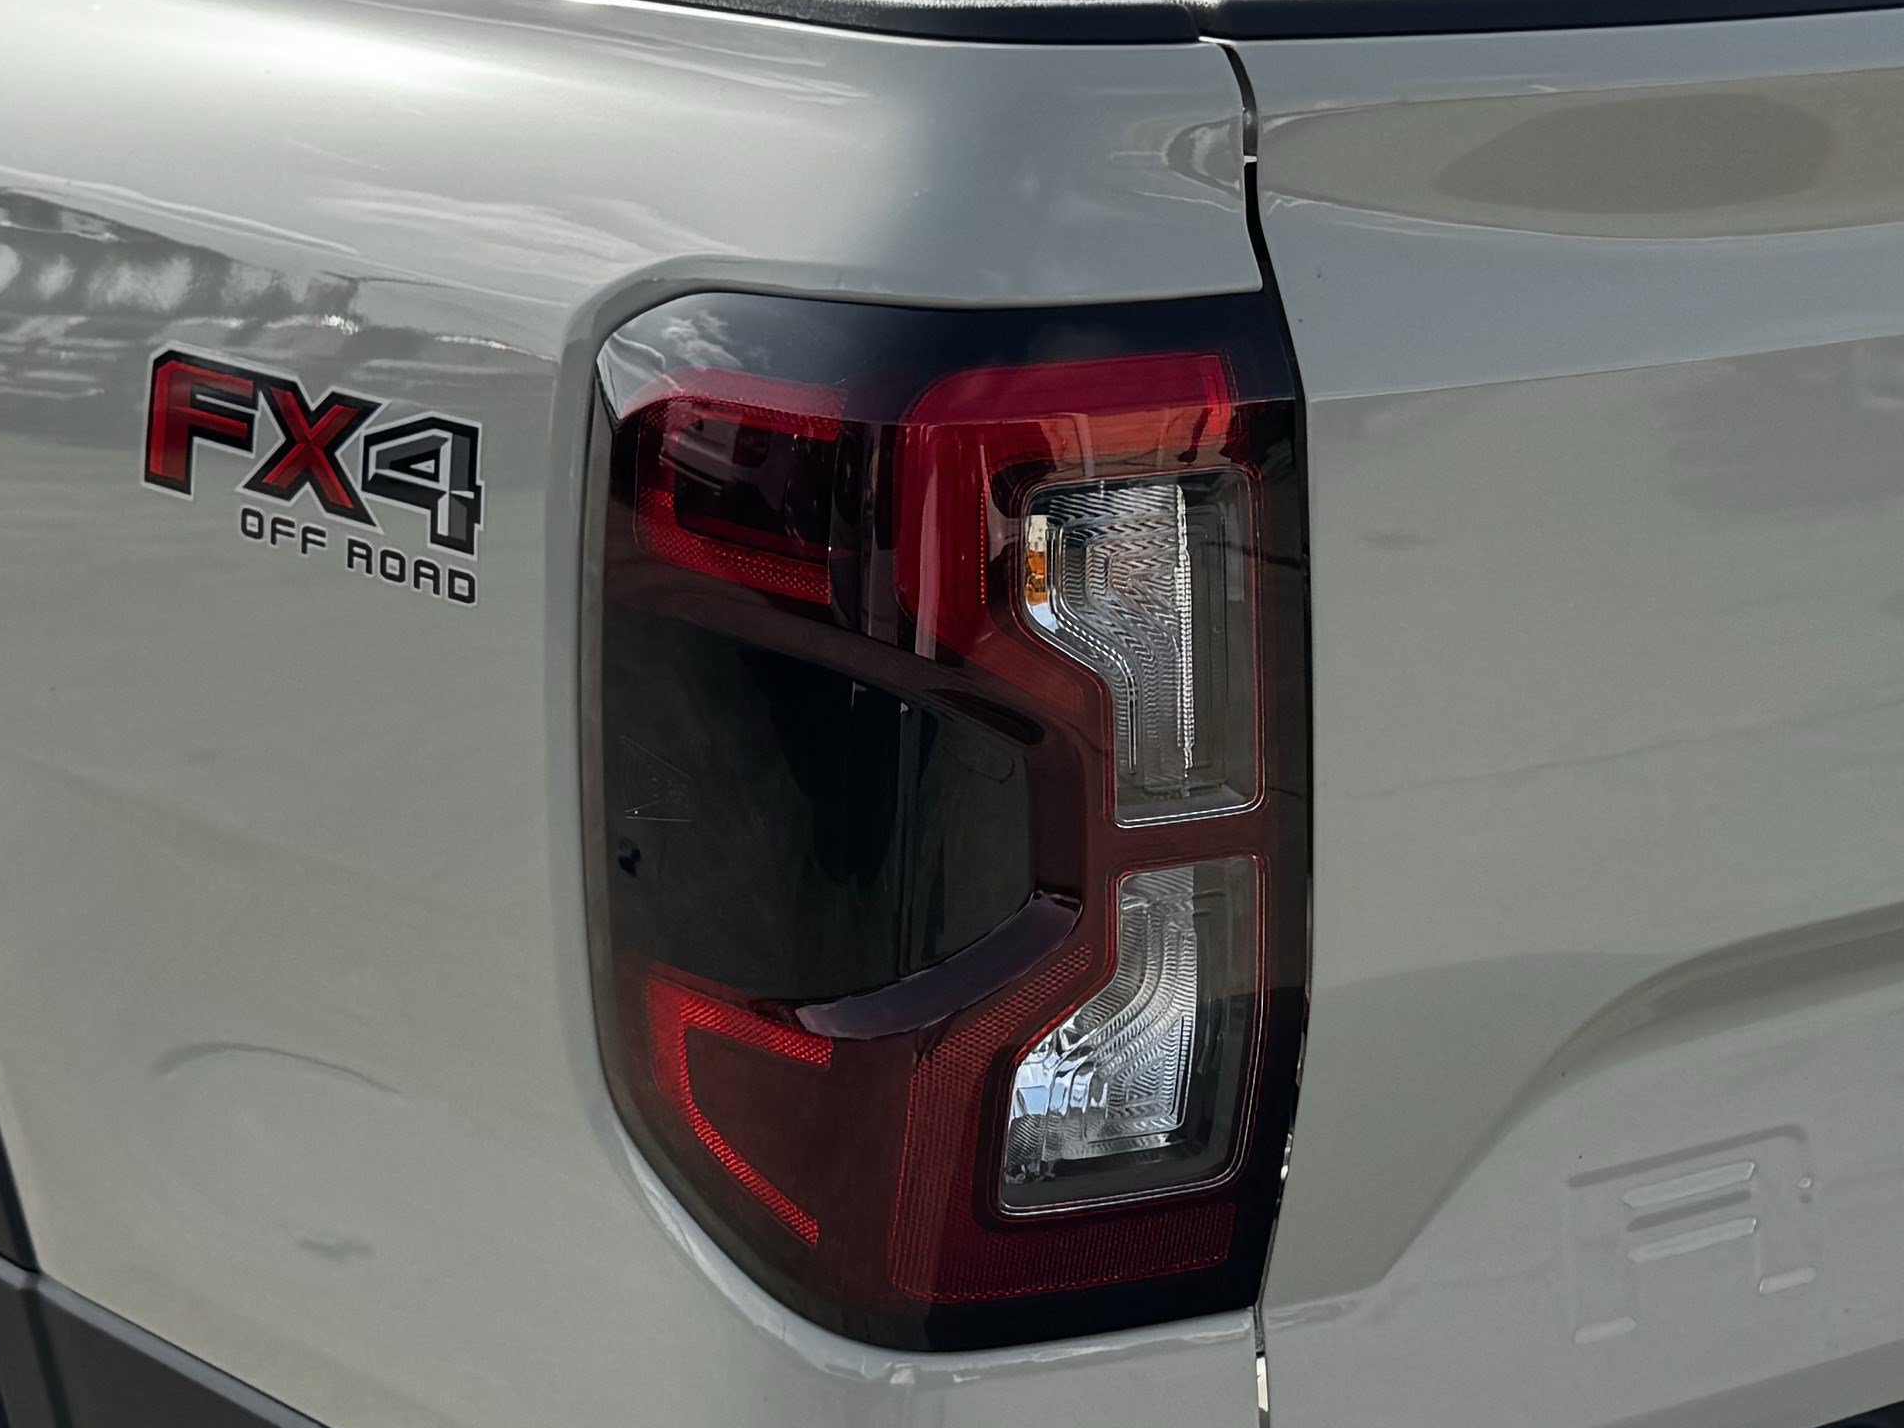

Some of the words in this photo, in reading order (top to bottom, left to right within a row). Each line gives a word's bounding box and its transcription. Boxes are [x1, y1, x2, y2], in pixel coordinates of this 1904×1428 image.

[141, 342, 486, 559] FX4
[240, 507, 328, 555] OFF
[345, 536, 478, 606] ROAD
